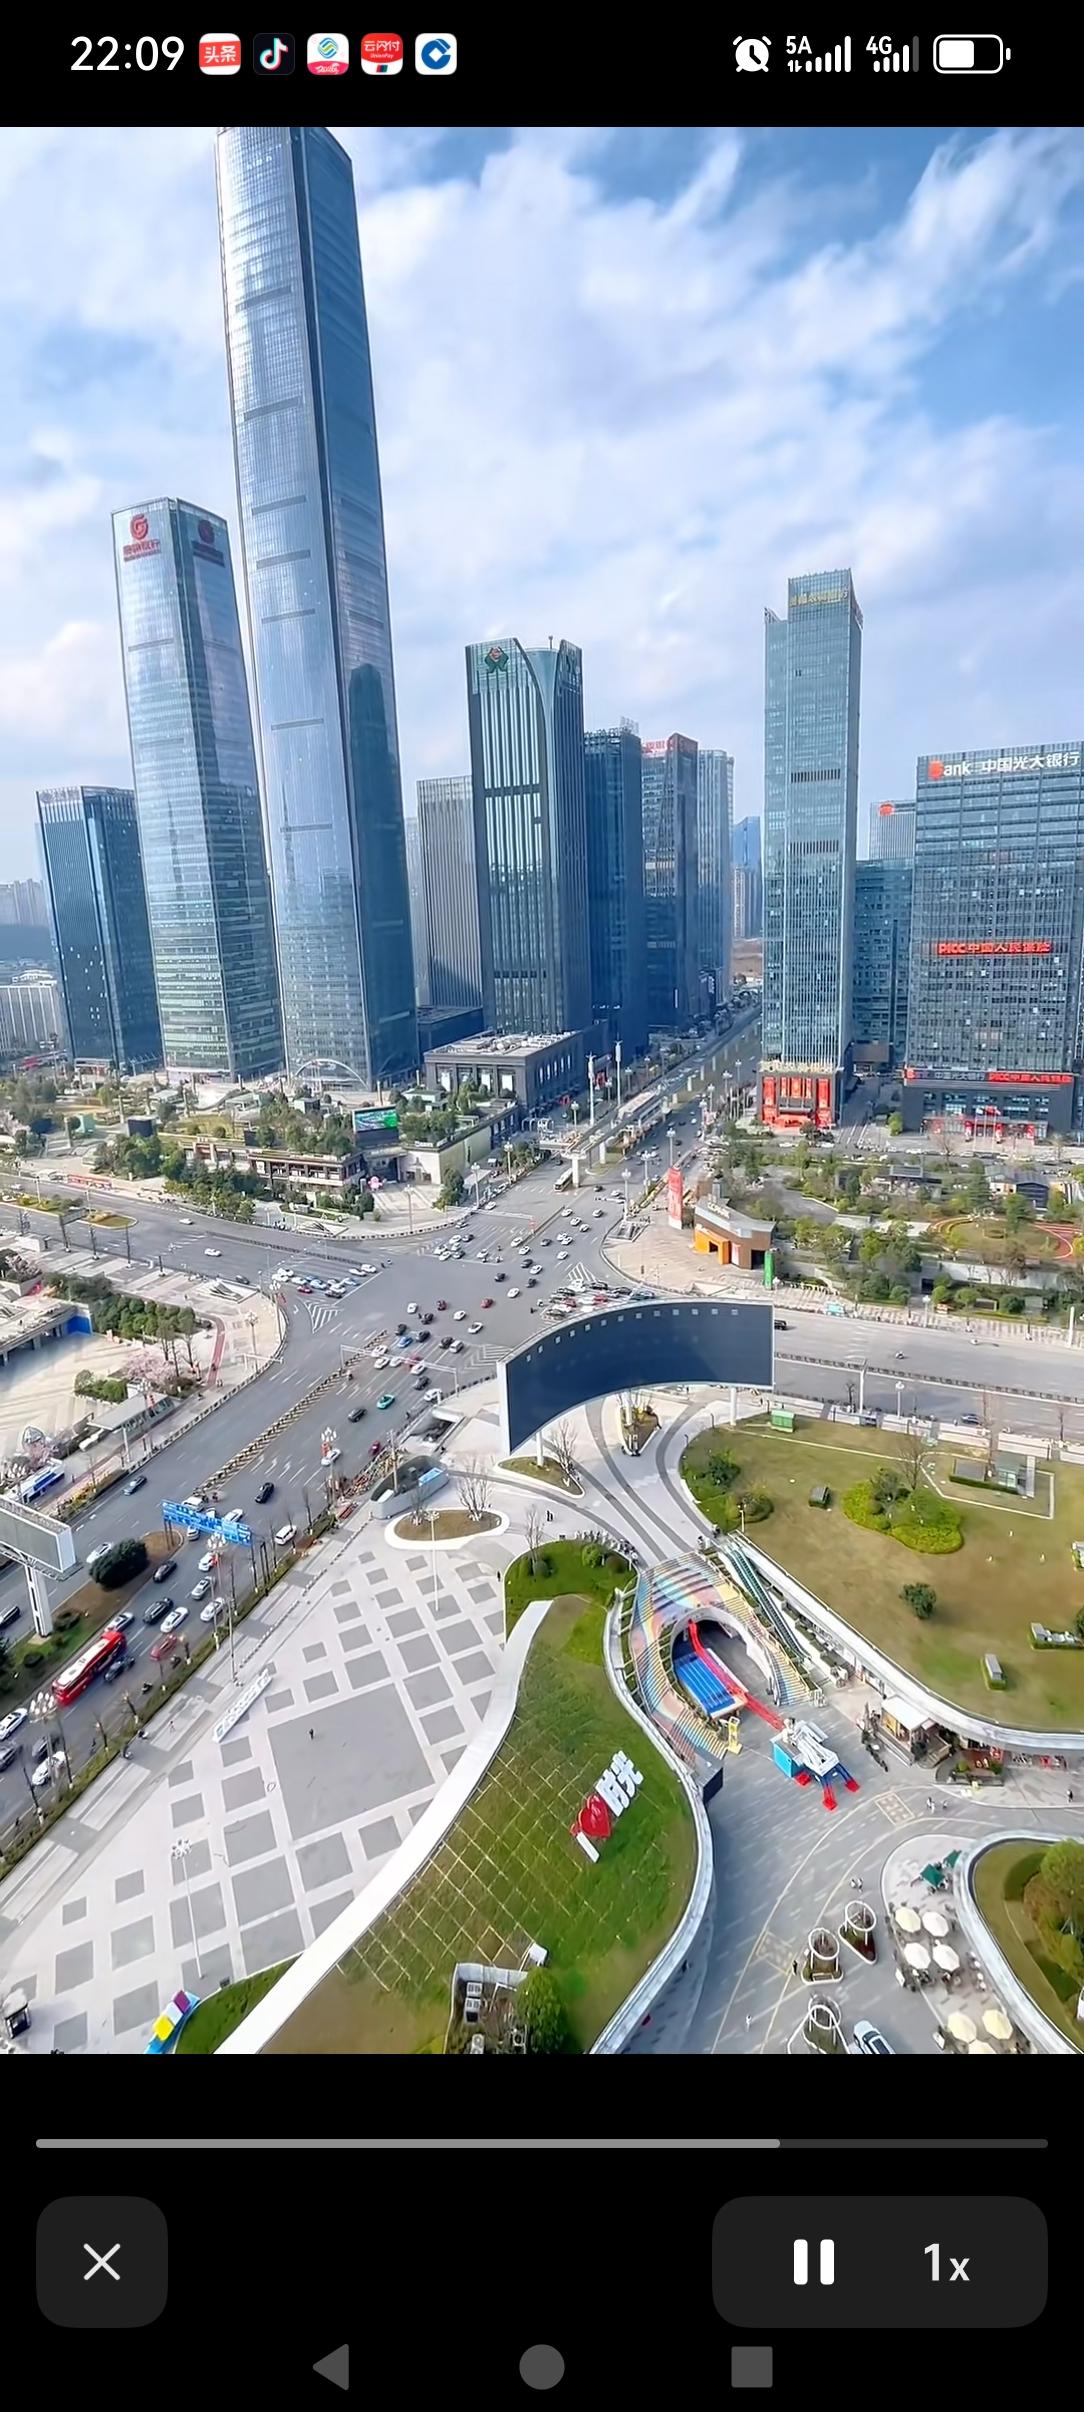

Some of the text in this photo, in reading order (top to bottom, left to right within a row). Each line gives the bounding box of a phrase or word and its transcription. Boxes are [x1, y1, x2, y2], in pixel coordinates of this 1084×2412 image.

[981, 751, 1080, 773] 中国光大银行
